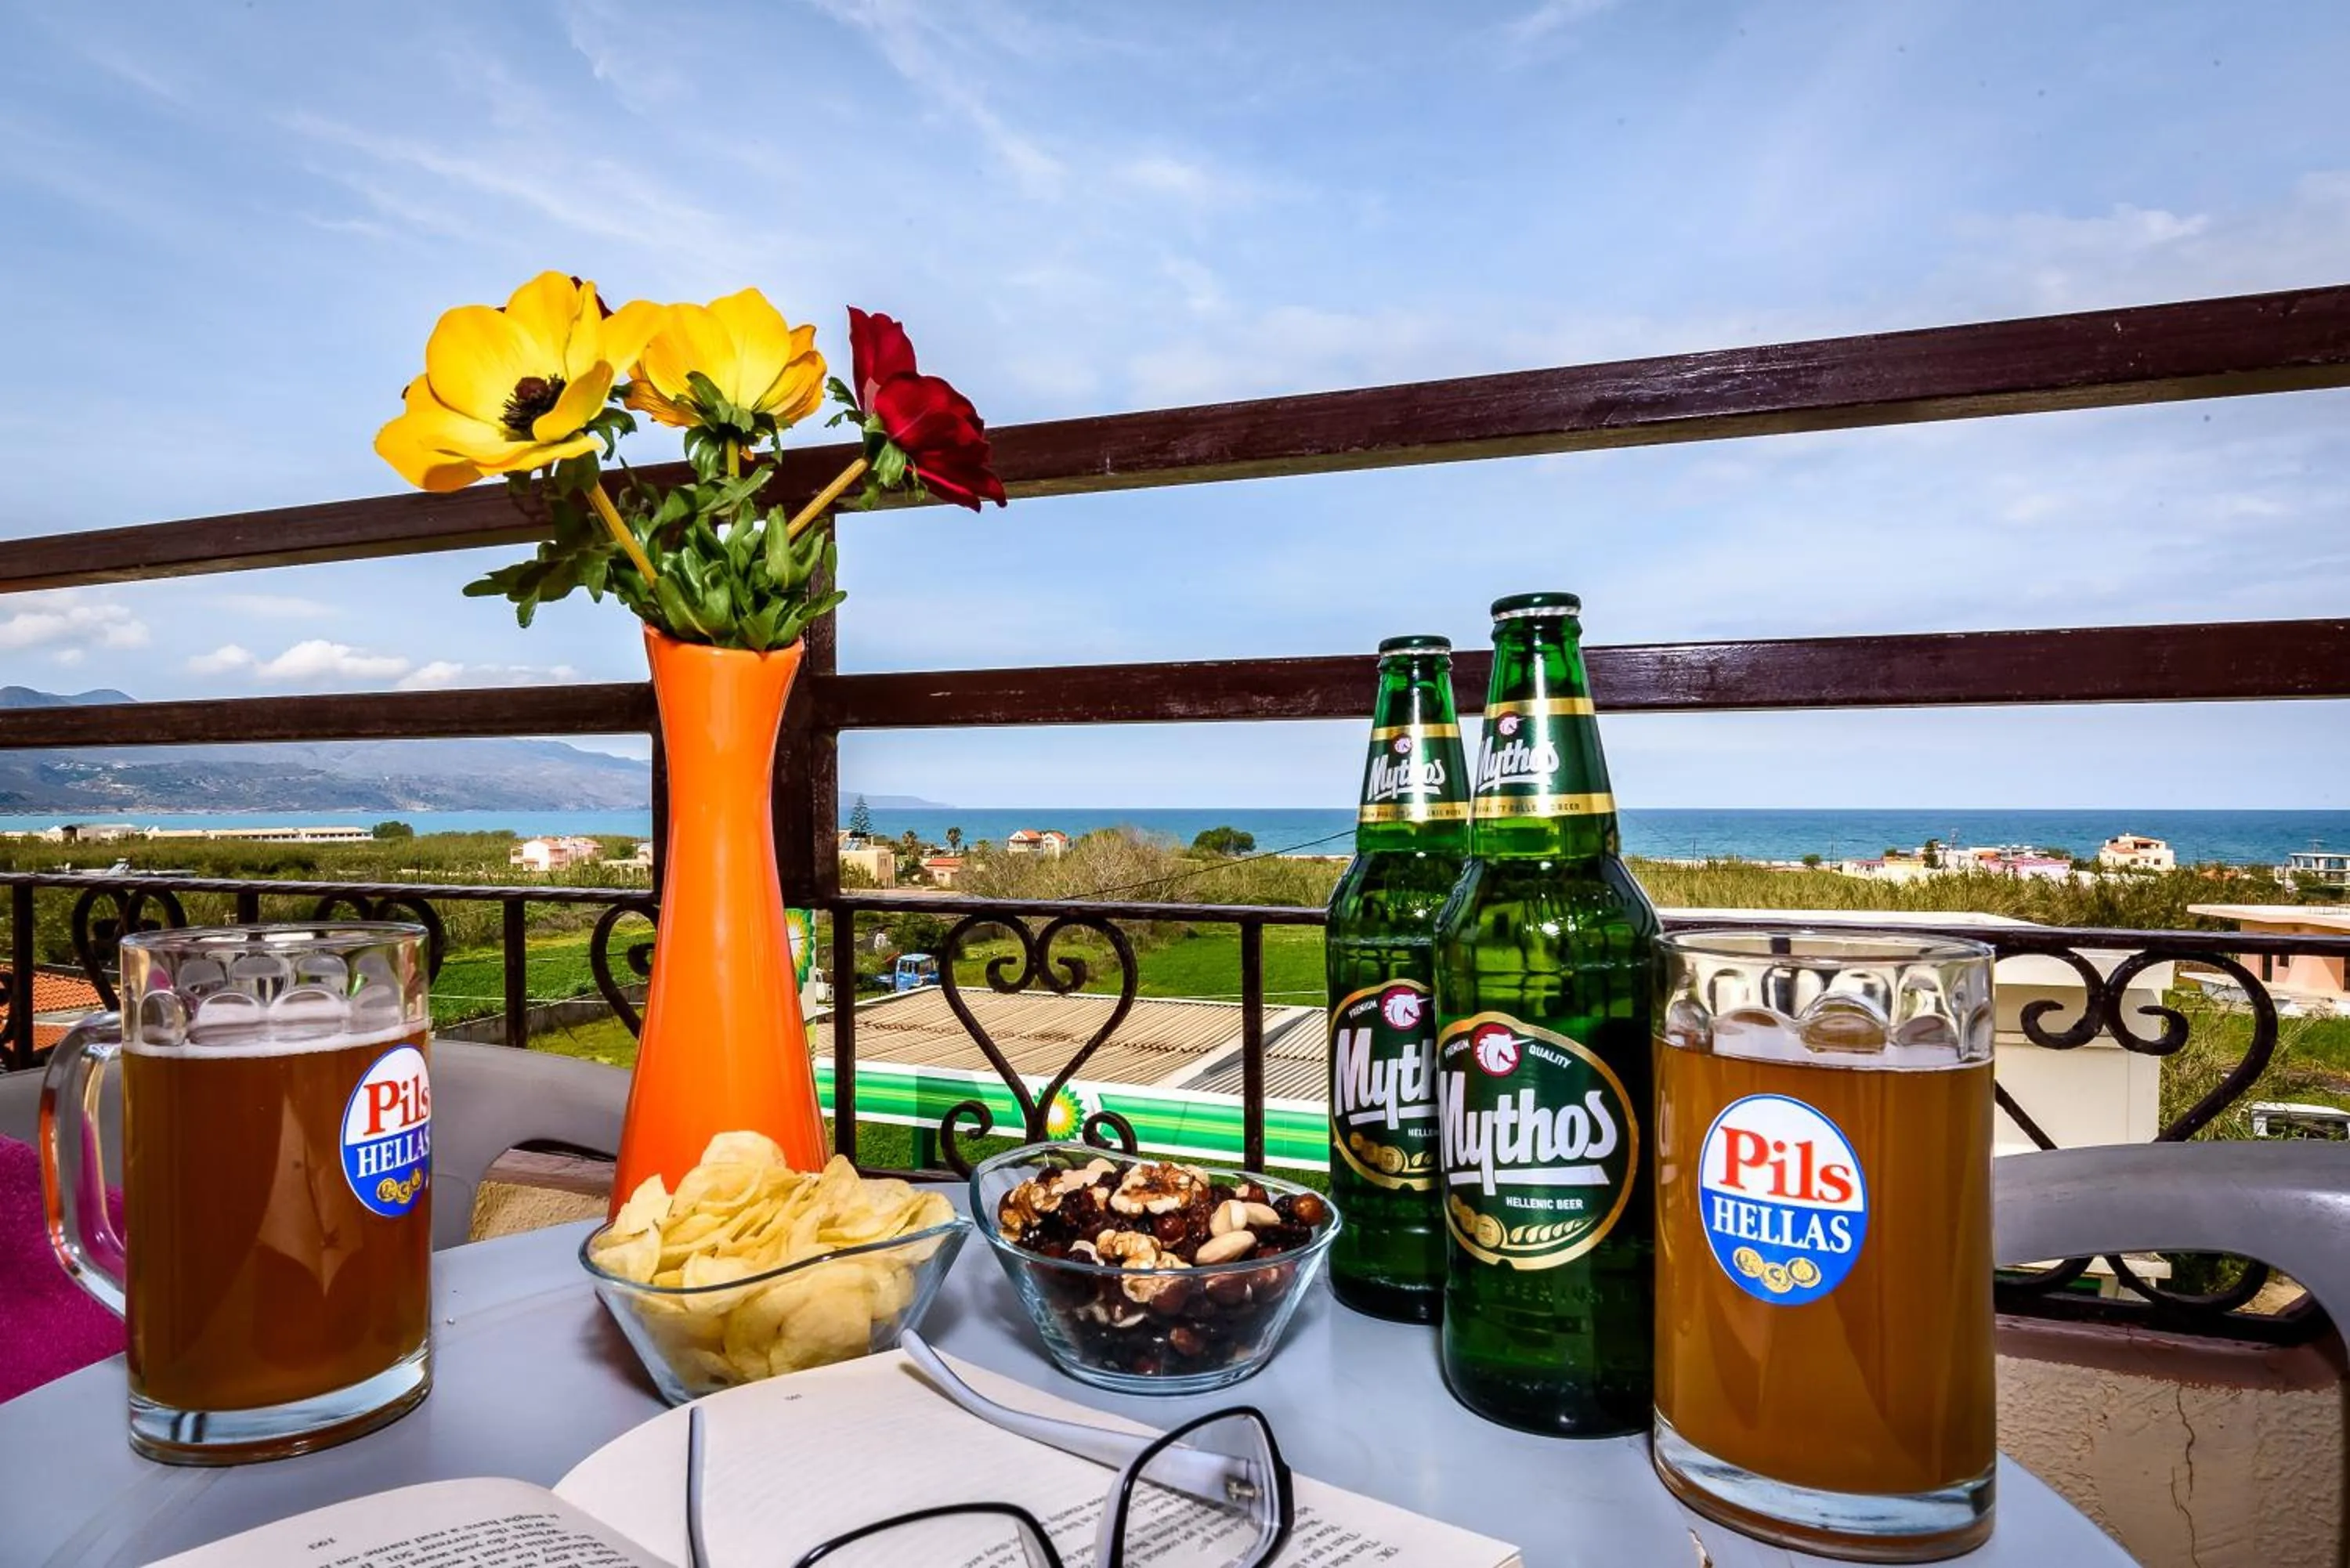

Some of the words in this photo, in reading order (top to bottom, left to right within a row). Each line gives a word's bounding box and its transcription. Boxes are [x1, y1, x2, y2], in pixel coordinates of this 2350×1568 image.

[1334, 1026, 1438, 1130] Myth
[1528, 1044, 1573, 1069] QUALITY
[363, 1074, 429, 1136] Pils
[1408, 1127, 1439, 1137] HELLE
[356, 1125, 430, 1178] HELLAS
[1439, 1071, 1618, 1196] Mythos
[1718, 1125, 1854, 1204] Pils
[1506, 1196, 1553, 1210] HELLENIC
[1556, 1198, 1583, 1211] BEER
[1711, 1195, 1853, 1254] HELLAS
[363, 1541, 410, 1557] name
